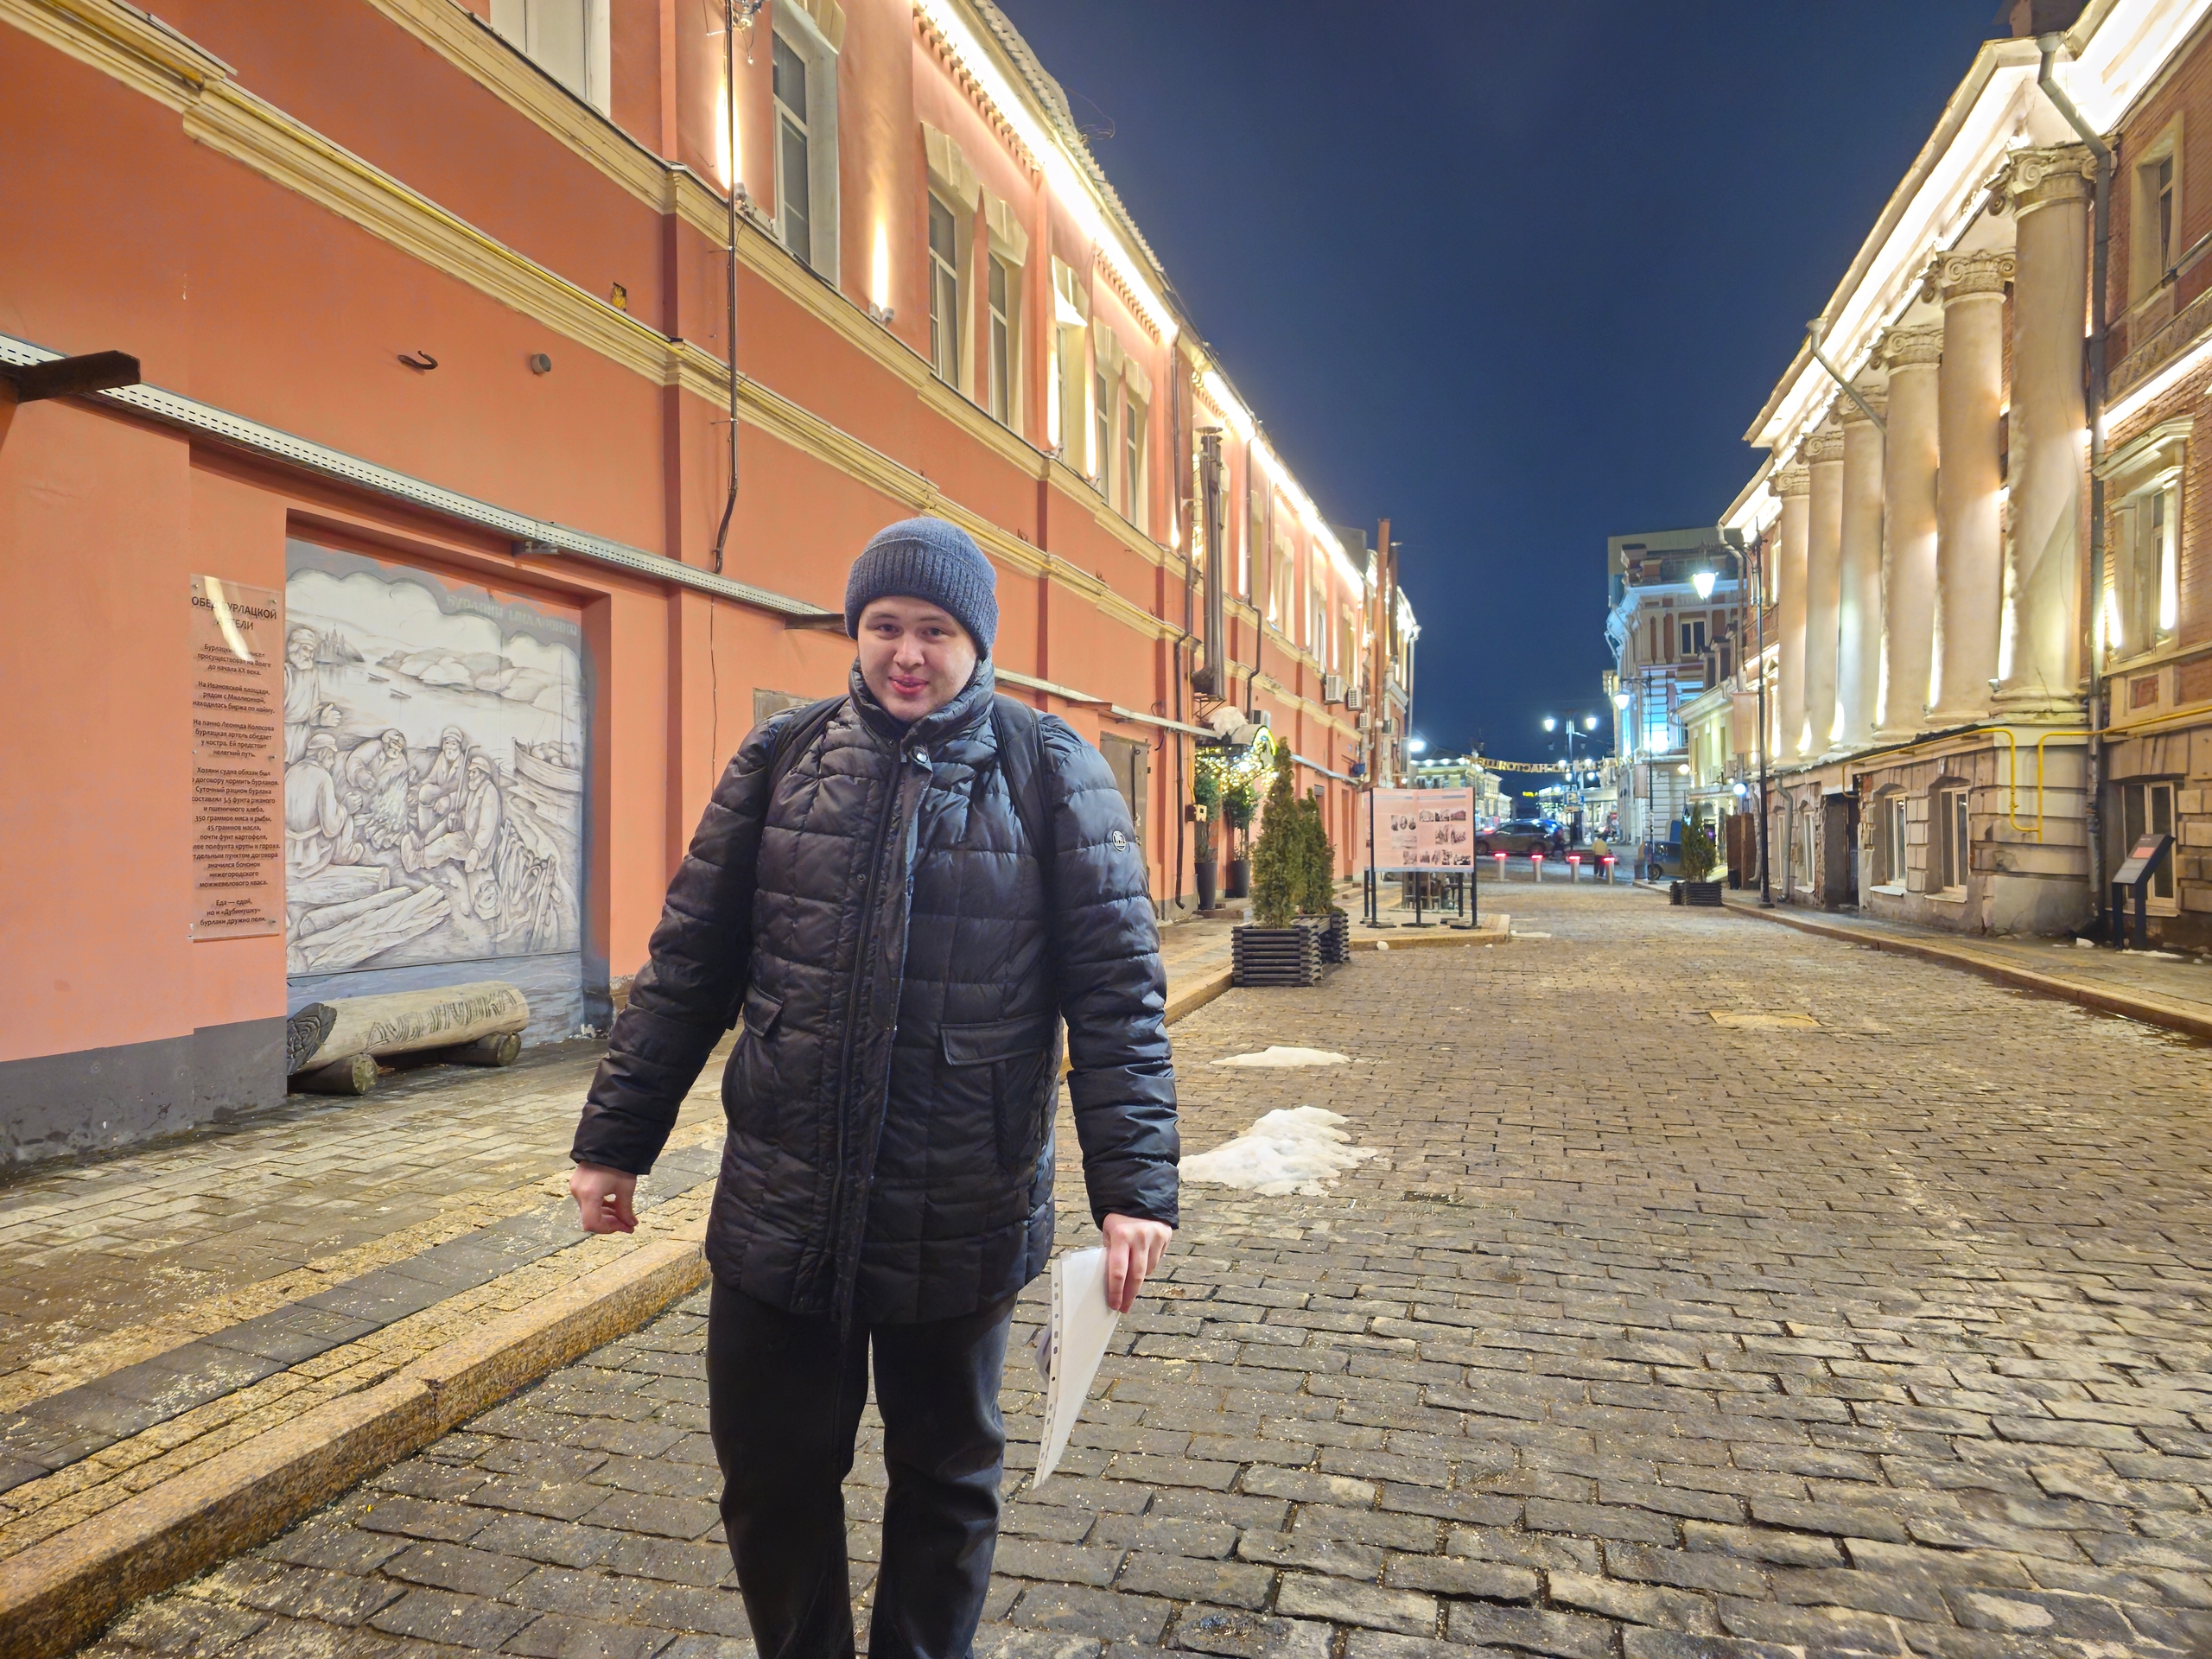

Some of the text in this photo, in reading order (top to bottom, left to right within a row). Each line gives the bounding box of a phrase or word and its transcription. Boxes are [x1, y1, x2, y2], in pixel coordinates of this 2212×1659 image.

[222, 602, 276, 620] БУРЛАЦКОЙ
[205, 644, 235, 653] Бурлацки
[198, 653, 245, 664] просуществовал
[207, 683, 243, 691] Ивановской
[228, 694, 265, 703] Миллионкой,
